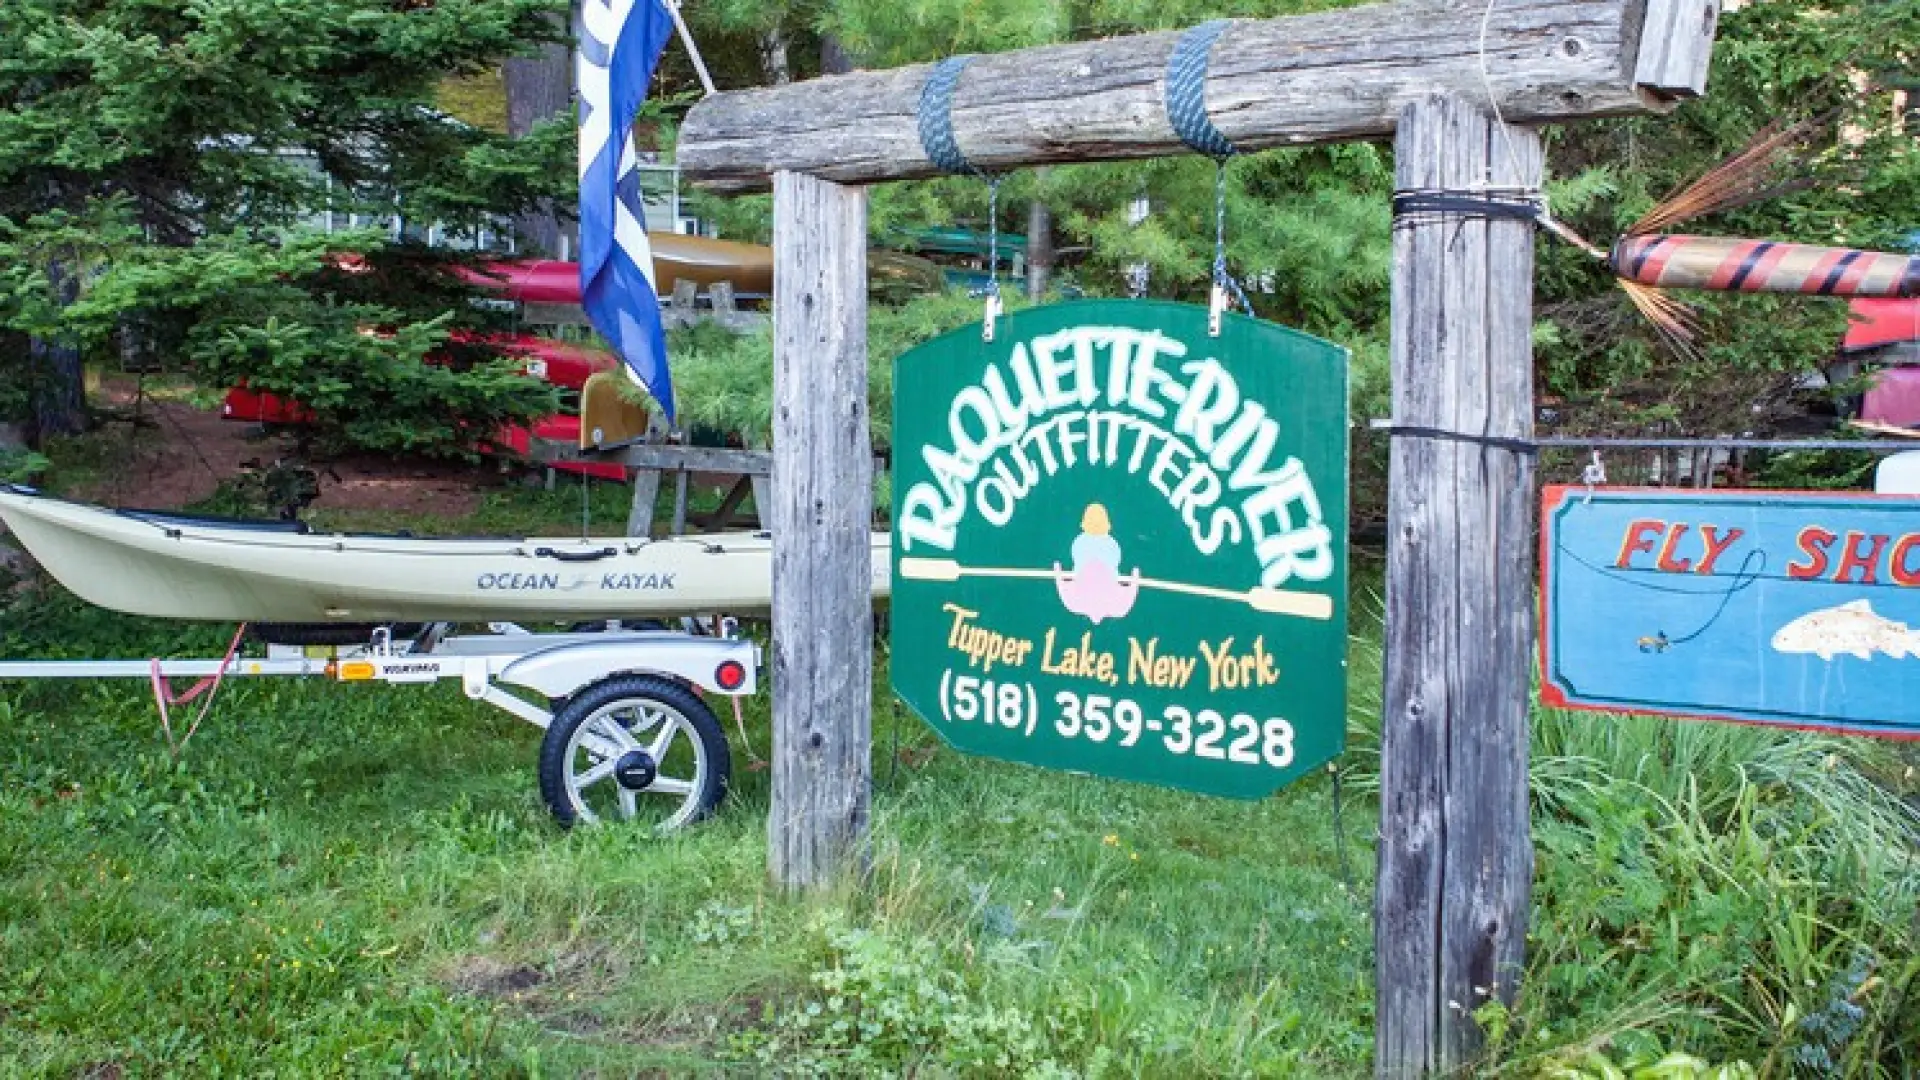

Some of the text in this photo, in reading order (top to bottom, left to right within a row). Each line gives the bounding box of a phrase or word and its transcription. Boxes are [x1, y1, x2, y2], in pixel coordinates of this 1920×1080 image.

[975, 408, 1243, 555] OUTFITTERS
[476, 572, 678, 591] OCEAN KAYAK
[1613, 516, 1746, 577] FLY
[942, 602, 1281, 693] Tupper Lake, New York
[938, 667, 1296, 769] (518) 359-3228
